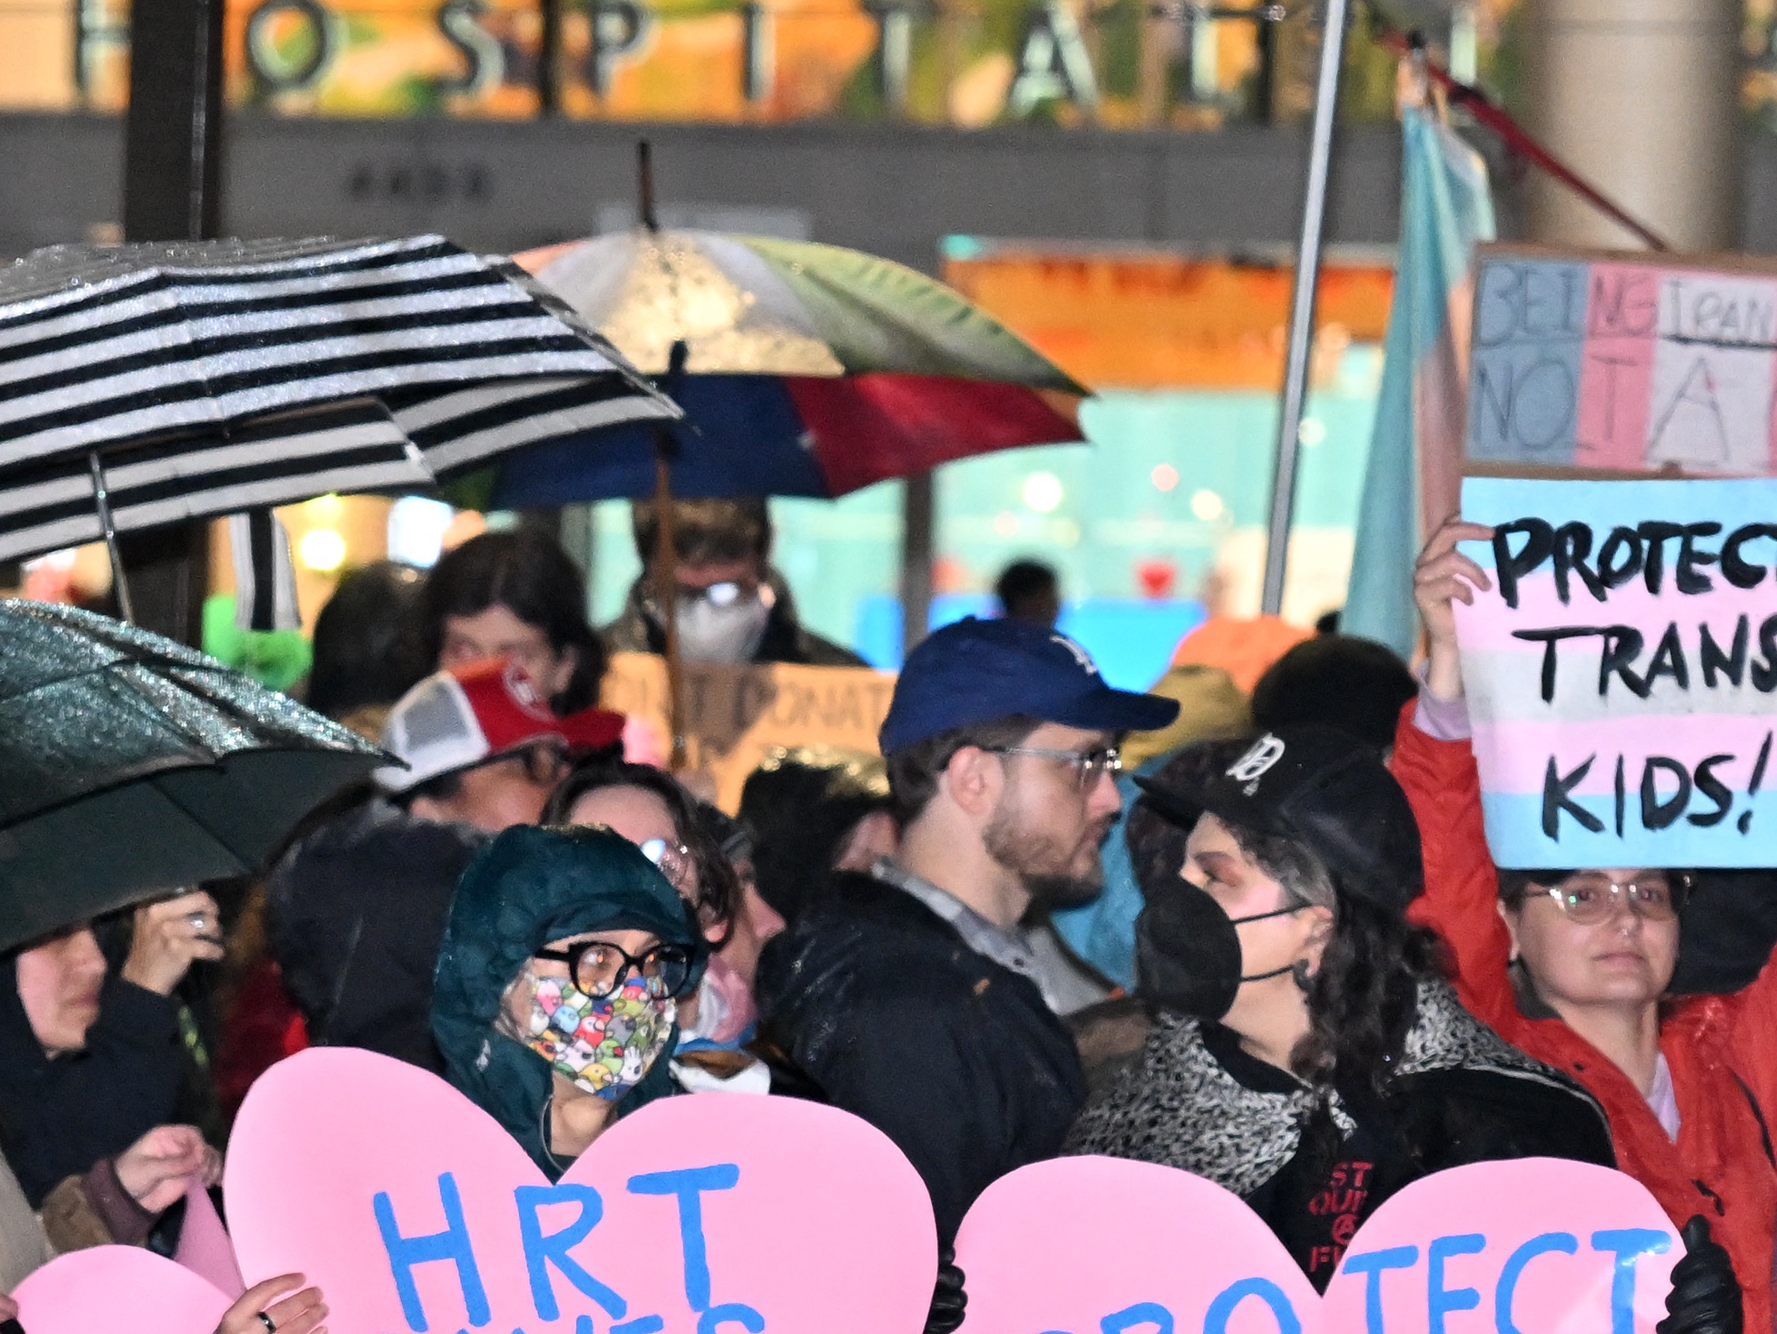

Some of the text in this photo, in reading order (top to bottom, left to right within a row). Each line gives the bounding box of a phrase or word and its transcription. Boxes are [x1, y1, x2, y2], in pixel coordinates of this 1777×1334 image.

[1475, 262, 1656, 349] BEING
[1472, 348, 1640, 451] NOT
[1644, 355, 1730, 463] A
[1539, 729, 1774, 843] KIDS!
[371, 1161, 741, 1334] HRT
